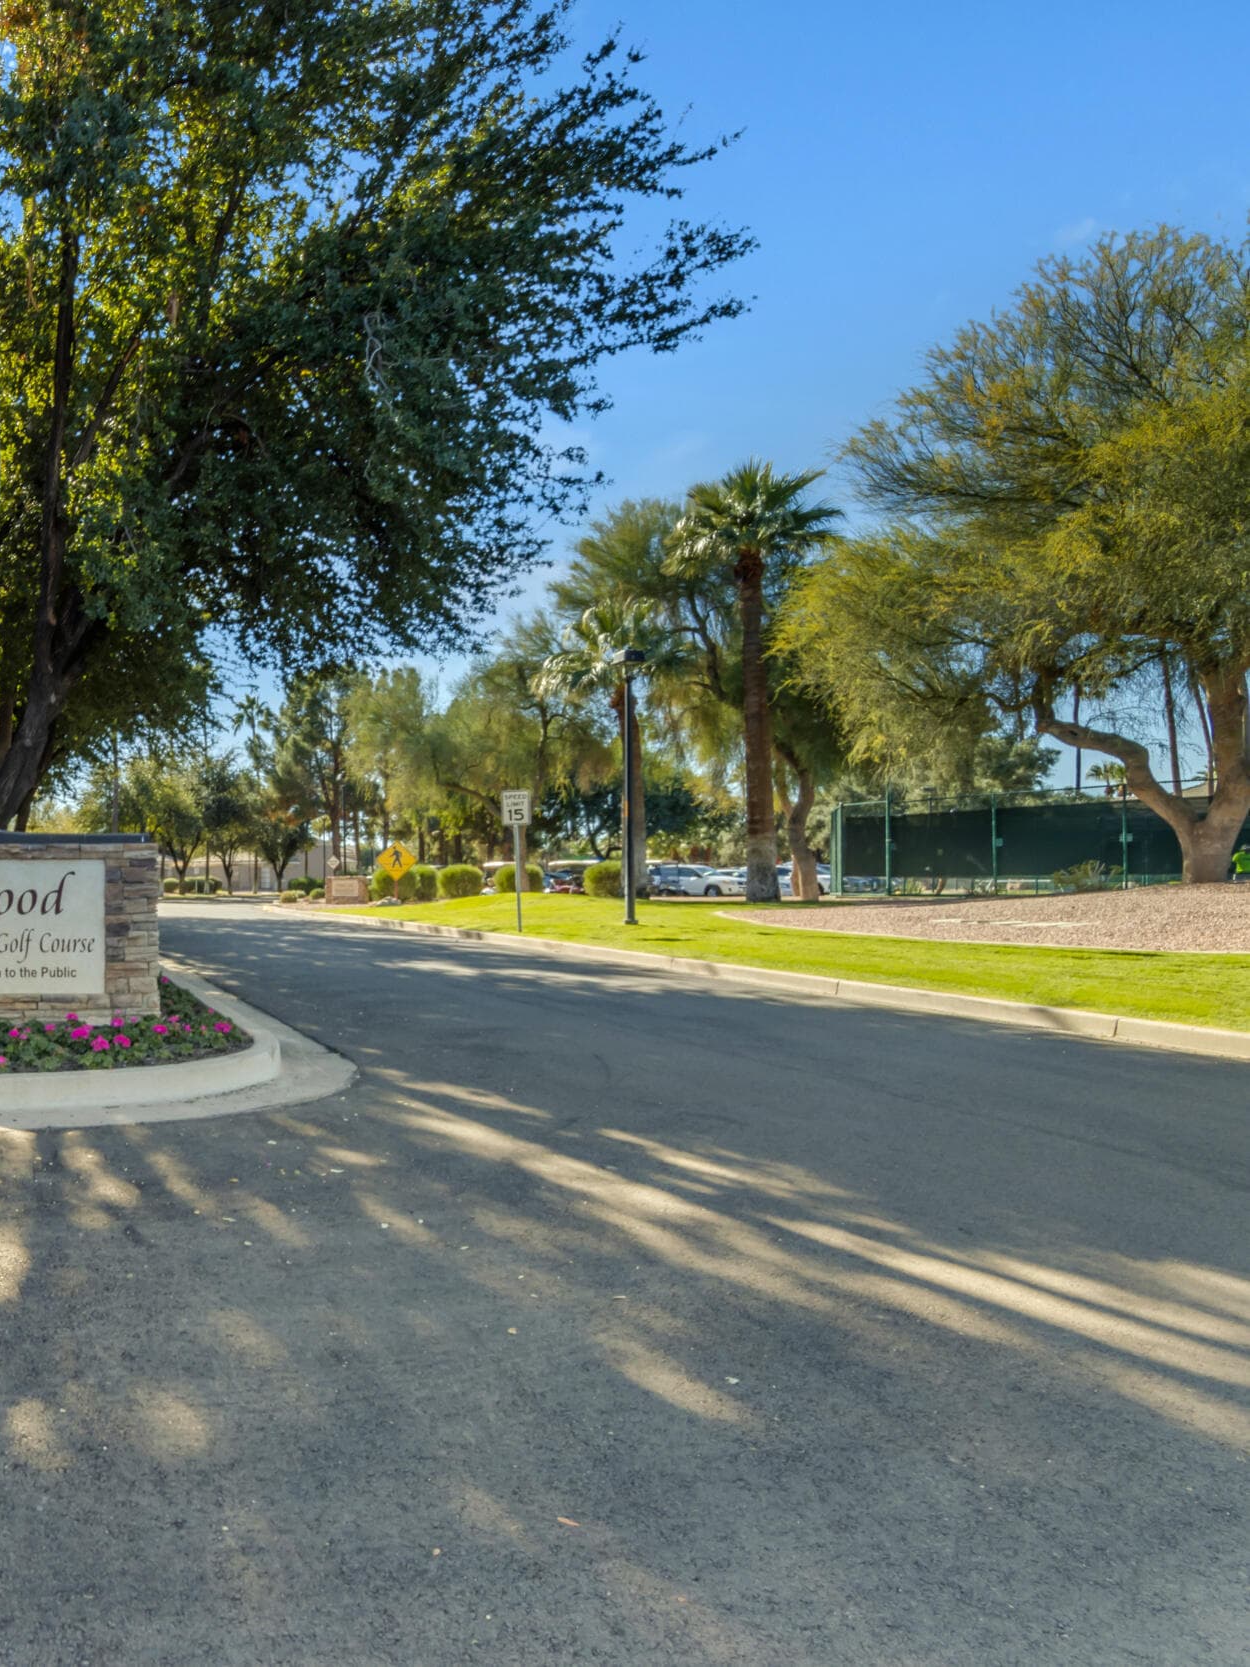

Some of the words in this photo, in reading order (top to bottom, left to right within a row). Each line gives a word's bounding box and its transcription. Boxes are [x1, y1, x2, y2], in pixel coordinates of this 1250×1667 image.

[507, 809, 525, 821] 15
[39, 932, 96, 954] Course
[4, 967, 16, 978] to
[19, 966, 38, 978] the
[41, 966, 77, 978] Public
